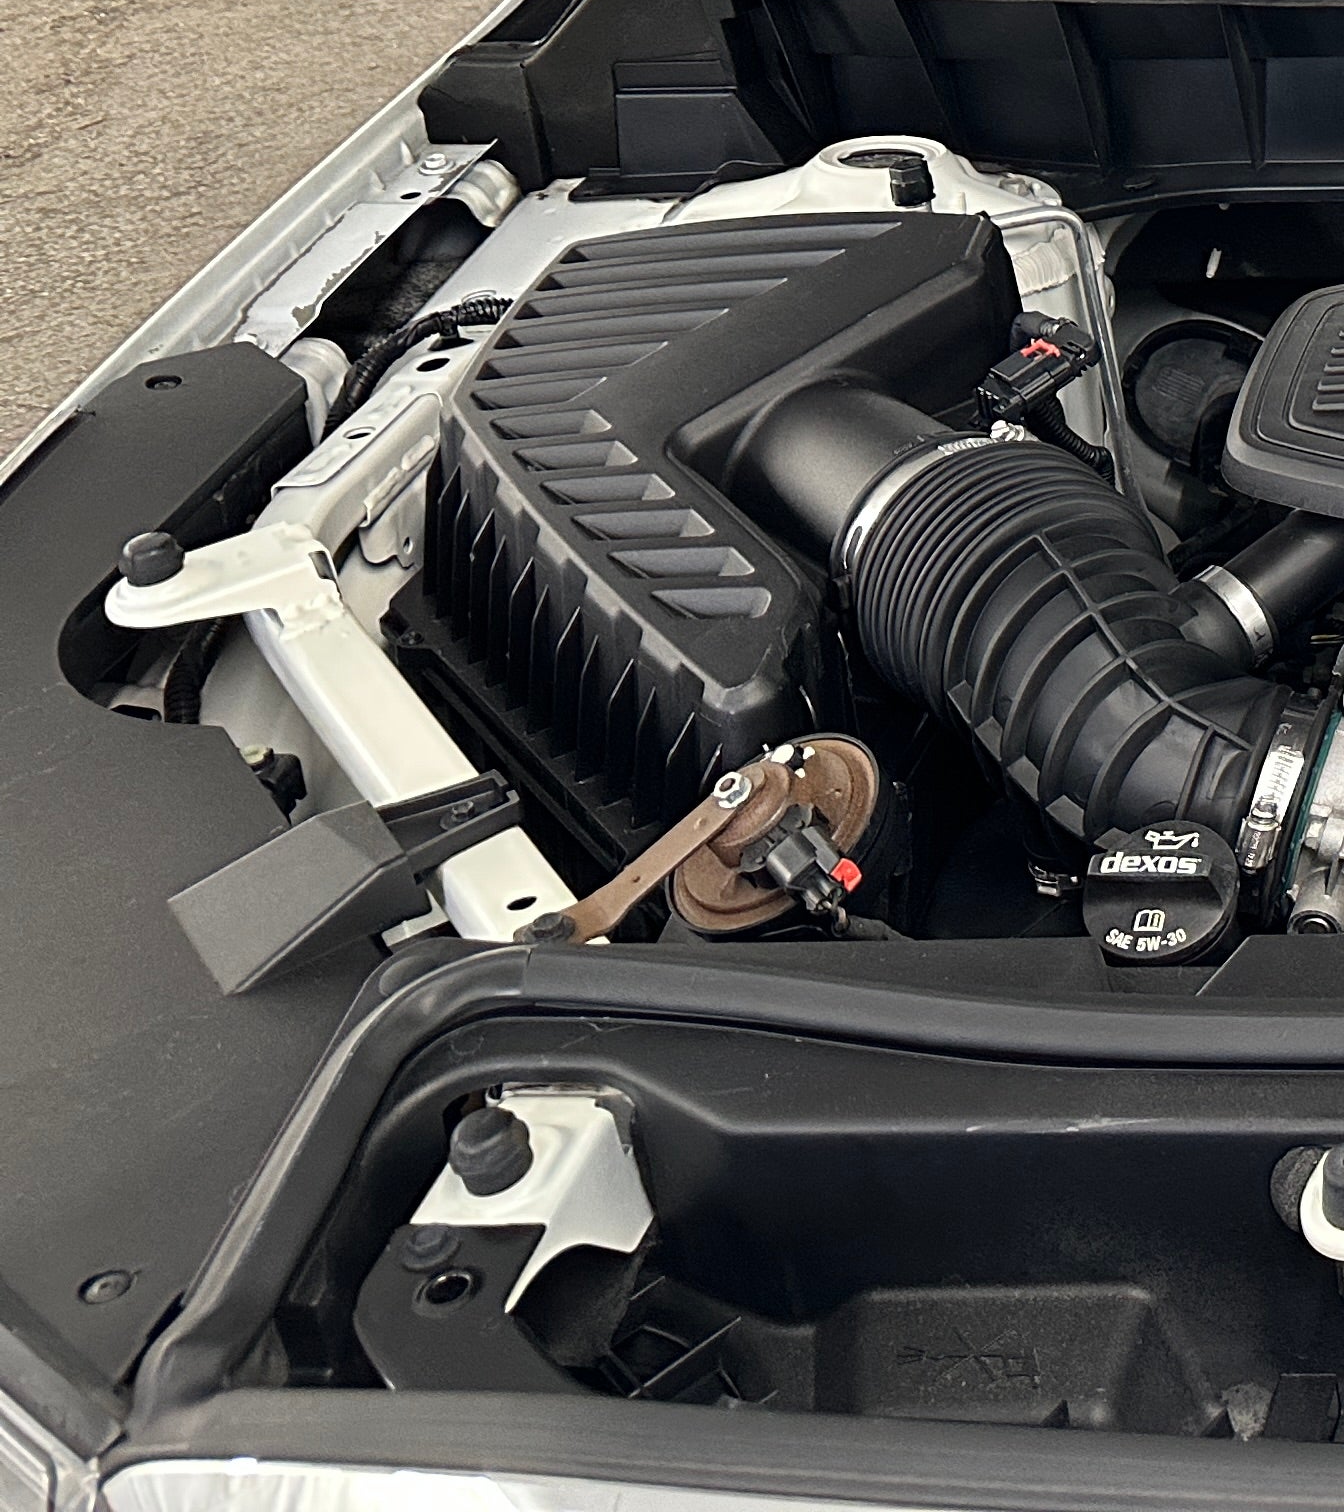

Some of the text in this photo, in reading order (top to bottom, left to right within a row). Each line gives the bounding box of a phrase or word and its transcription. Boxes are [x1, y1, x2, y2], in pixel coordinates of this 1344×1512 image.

[1100, 851, 1201, 874] dexos
[1105, 928, 1187, 952] SAE 5W-30
